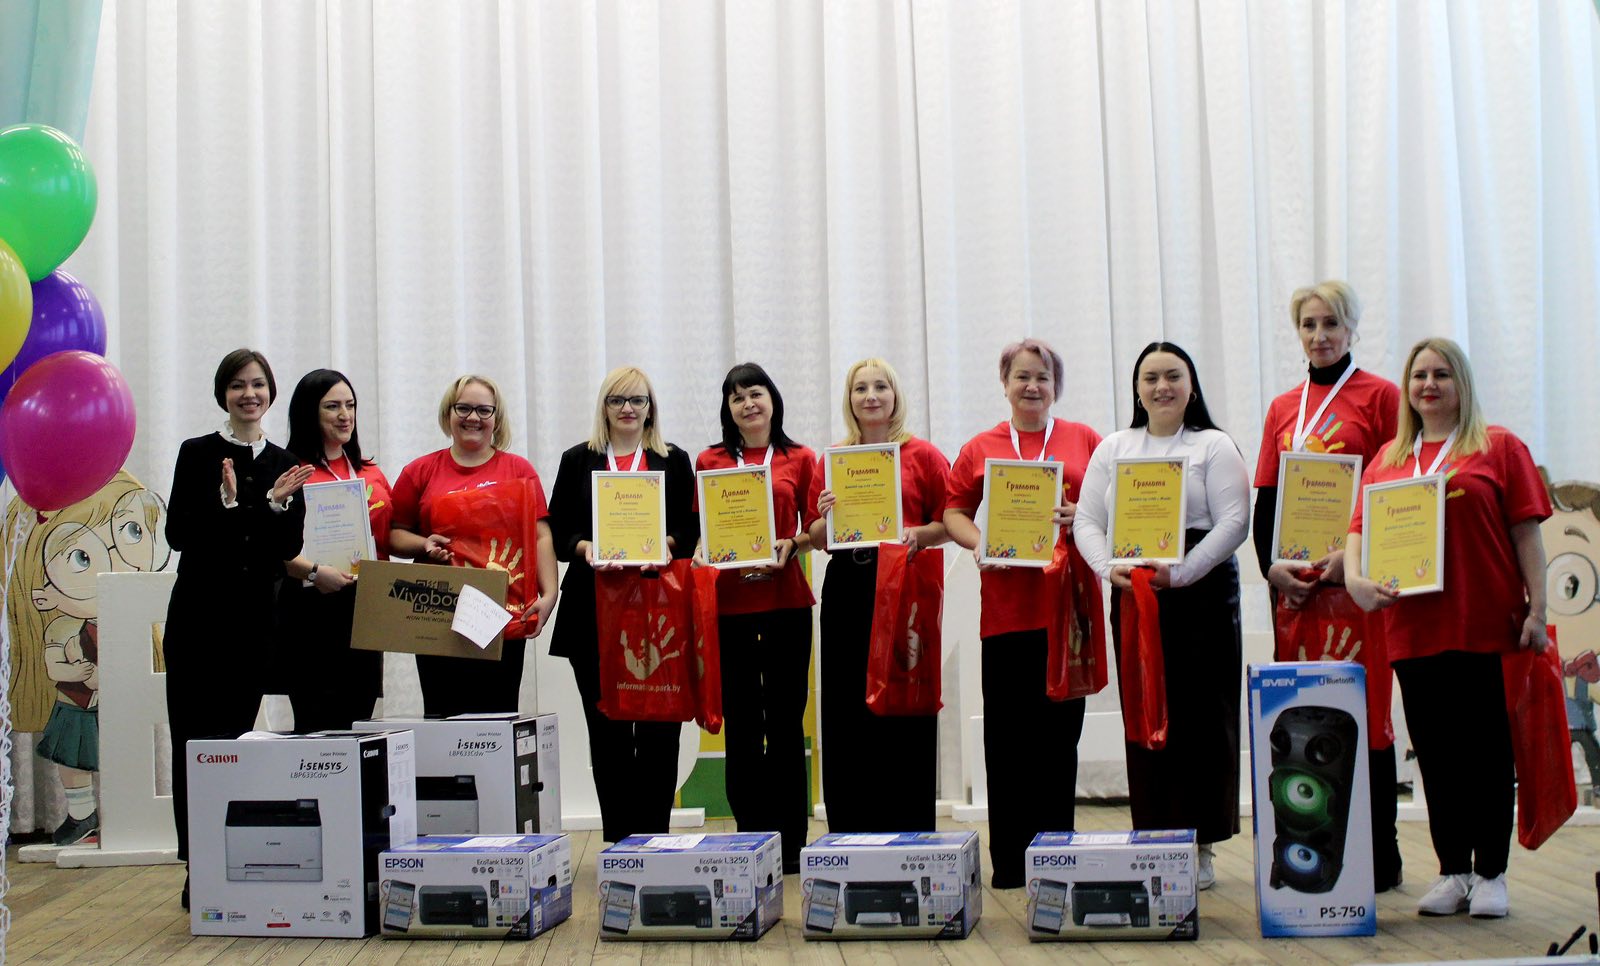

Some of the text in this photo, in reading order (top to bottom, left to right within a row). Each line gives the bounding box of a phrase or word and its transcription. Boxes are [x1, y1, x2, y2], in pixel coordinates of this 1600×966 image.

[847, 468, 879, 477] Грамота
[1006, 481, 1040, 491] Грамота
[1132, 479, 1166, 489] Грамота
[614, 491, 643, 500] Диплом
[721, 489, 750, 498] Диплом
[391, 585, 459, 607] Vivobo
[1262, 678, 1295, 687] SVEN
[197, 753, 238, 763] Canon
[501, 857, 523, 866] L3250
[724, 856, 749, 864] L3250
[807, 856, 849, 867] EPSON
[932, 853, 957, 862] L3250
[1033, 855, 1076, 866] EPSON
[1162, 852, 1189, 861] L3250
[385, 858, 424, 869] EPSON
[603, 858, 644, 869] EPSON
[1320, 906, 1365, 918] PS-750
